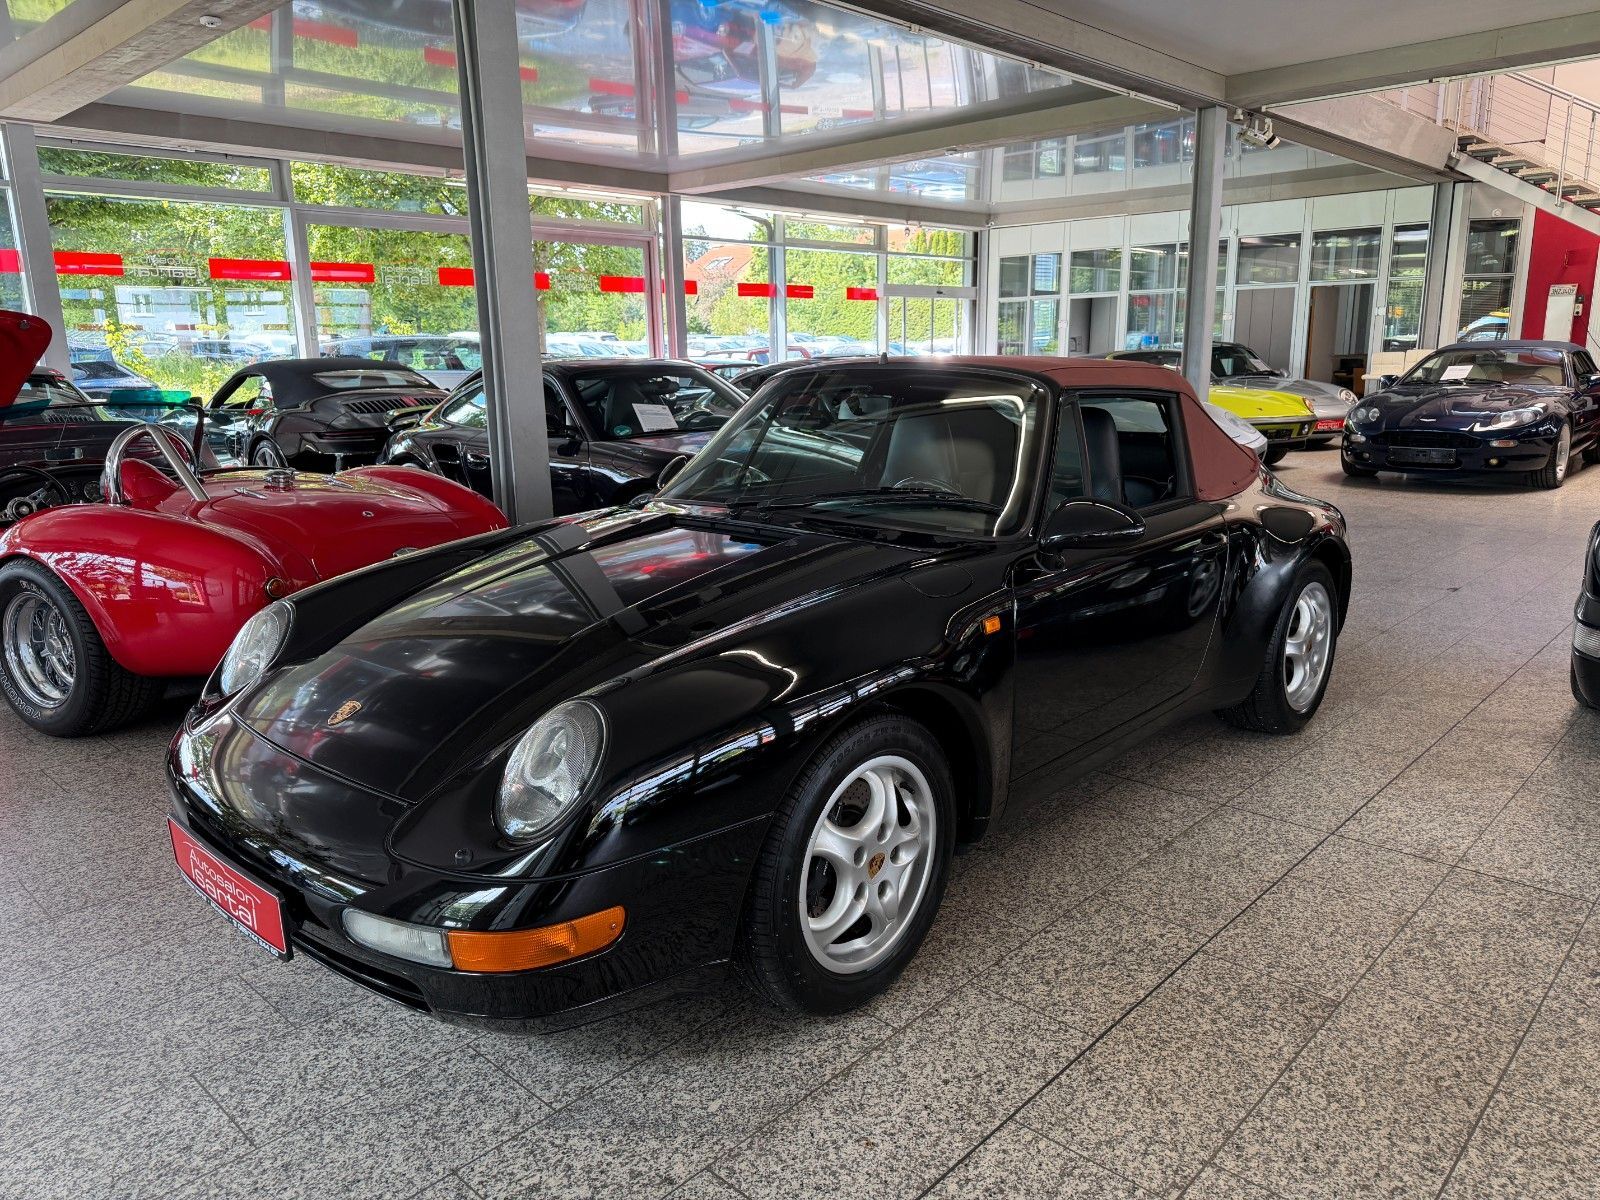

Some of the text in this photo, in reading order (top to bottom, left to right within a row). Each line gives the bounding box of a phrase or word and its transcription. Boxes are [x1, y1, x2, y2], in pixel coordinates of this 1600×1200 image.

[0, 660, 41, 720] YOKOHA
[190, 849, 254, 904] Autosalon
[191, 859, 257, 930] Isartal
